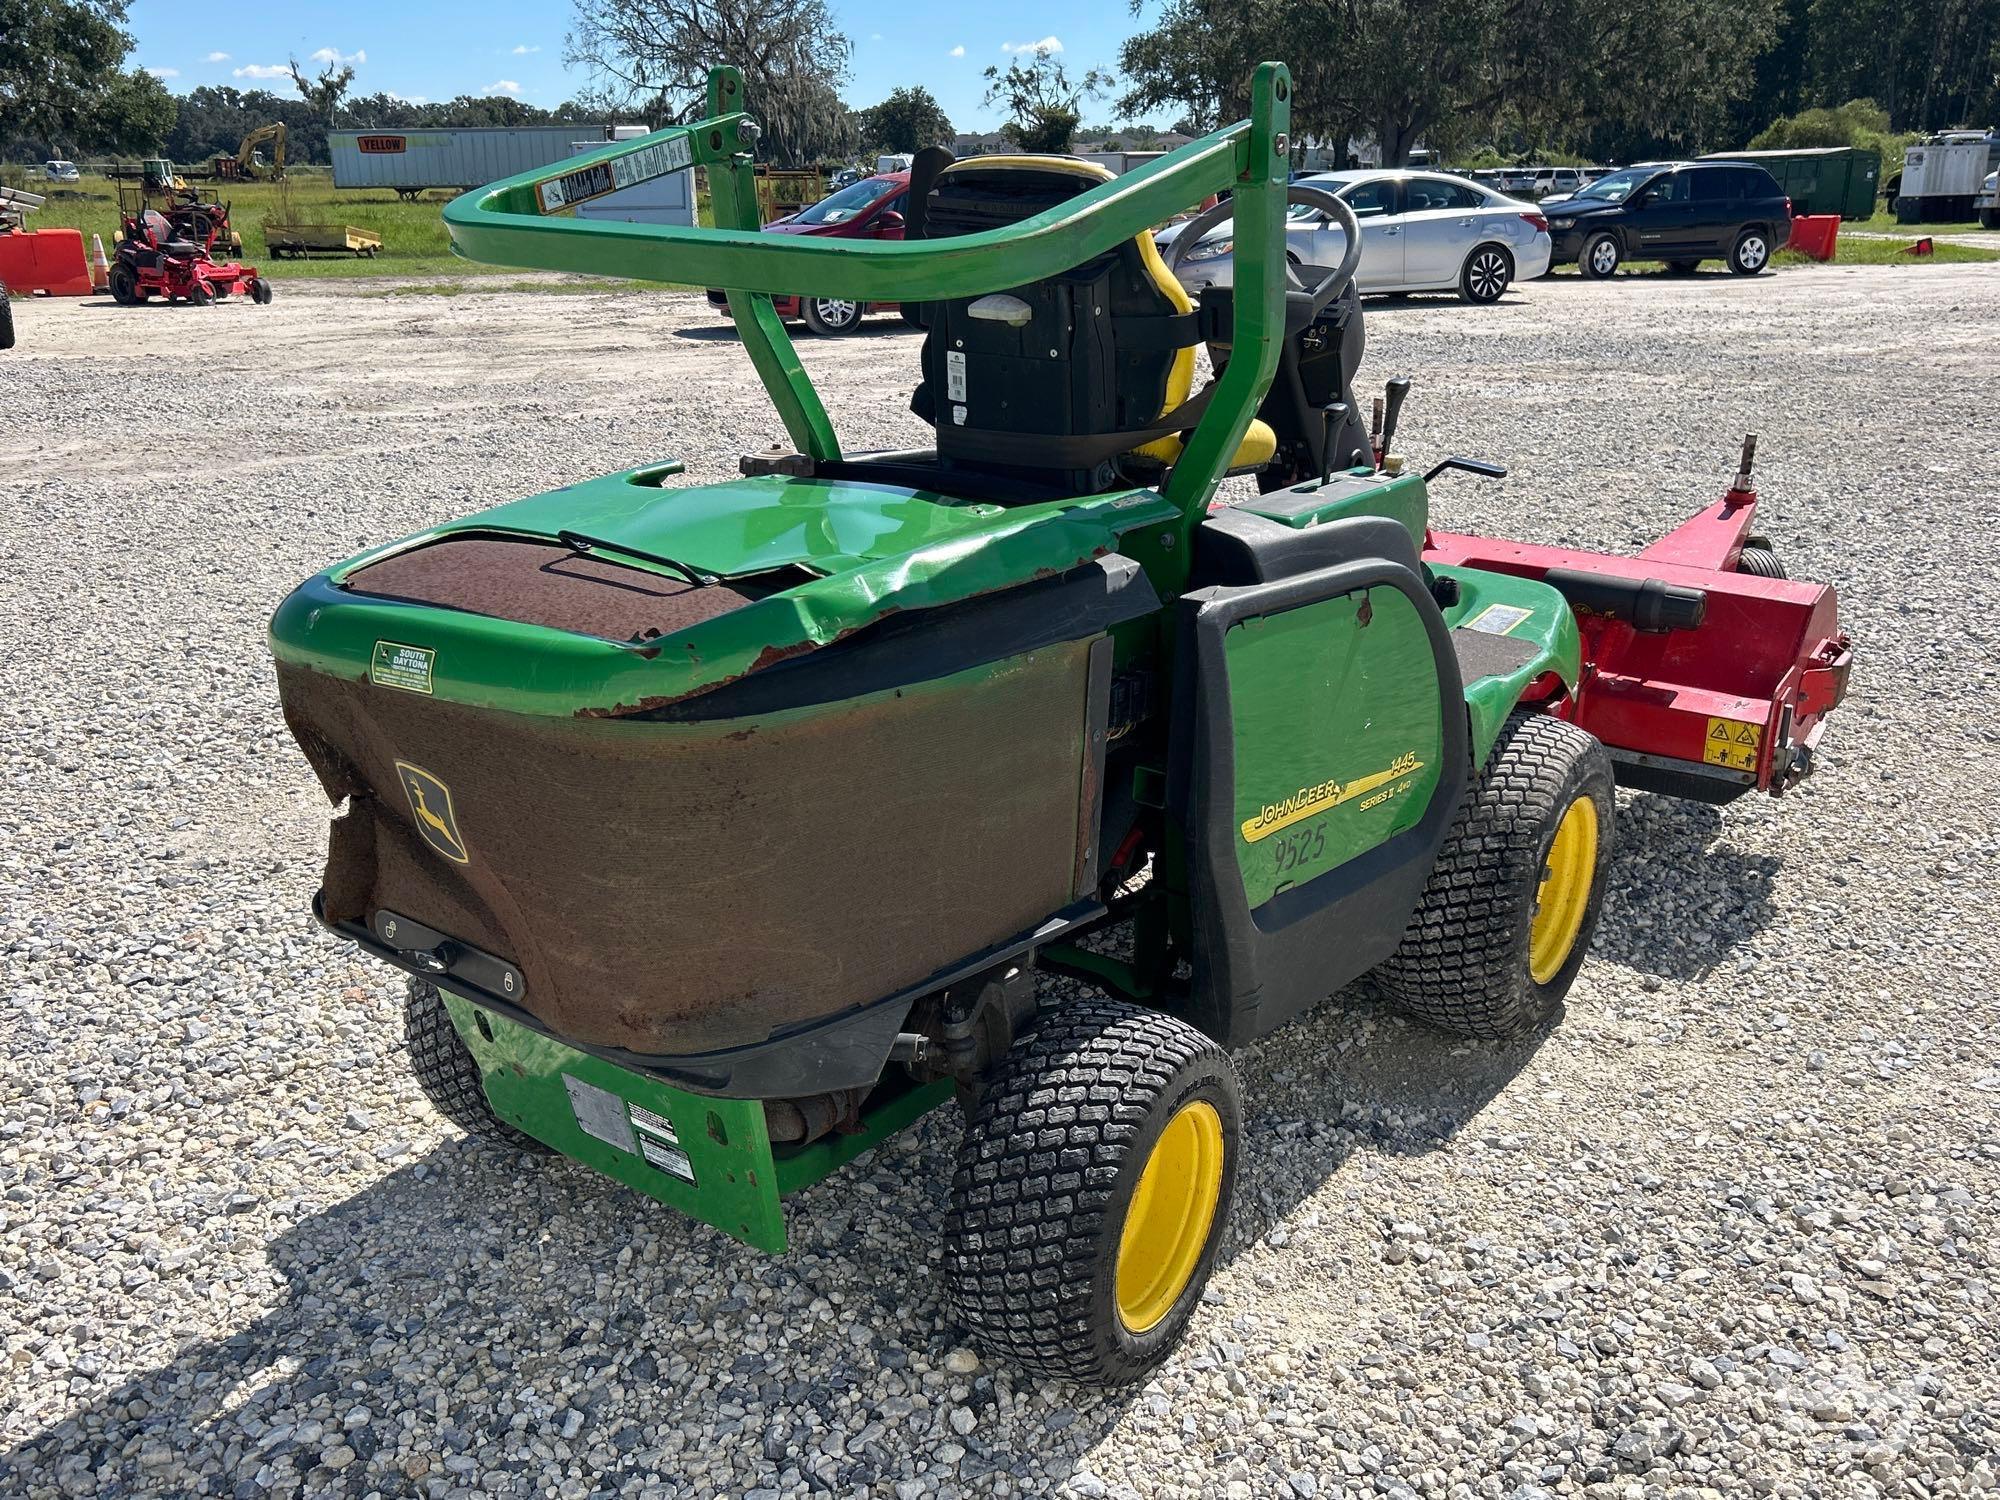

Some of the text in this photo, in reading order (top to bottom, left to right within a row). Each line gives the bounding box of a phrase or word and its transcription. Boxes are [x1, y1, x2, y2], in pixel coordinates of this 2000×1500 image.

[363, 139, 401, 150] YELLOW
[393, 656, 428, 670] DAYTONA
[399, 648, 426, 660] SOUTH
[1390, 751, 1416, 776] 1445
[1359, 790, 1388, 812] SERIES
[1254, 796, 1298, 830] JOHN
[1274, 822, 1328, 876] 9525
